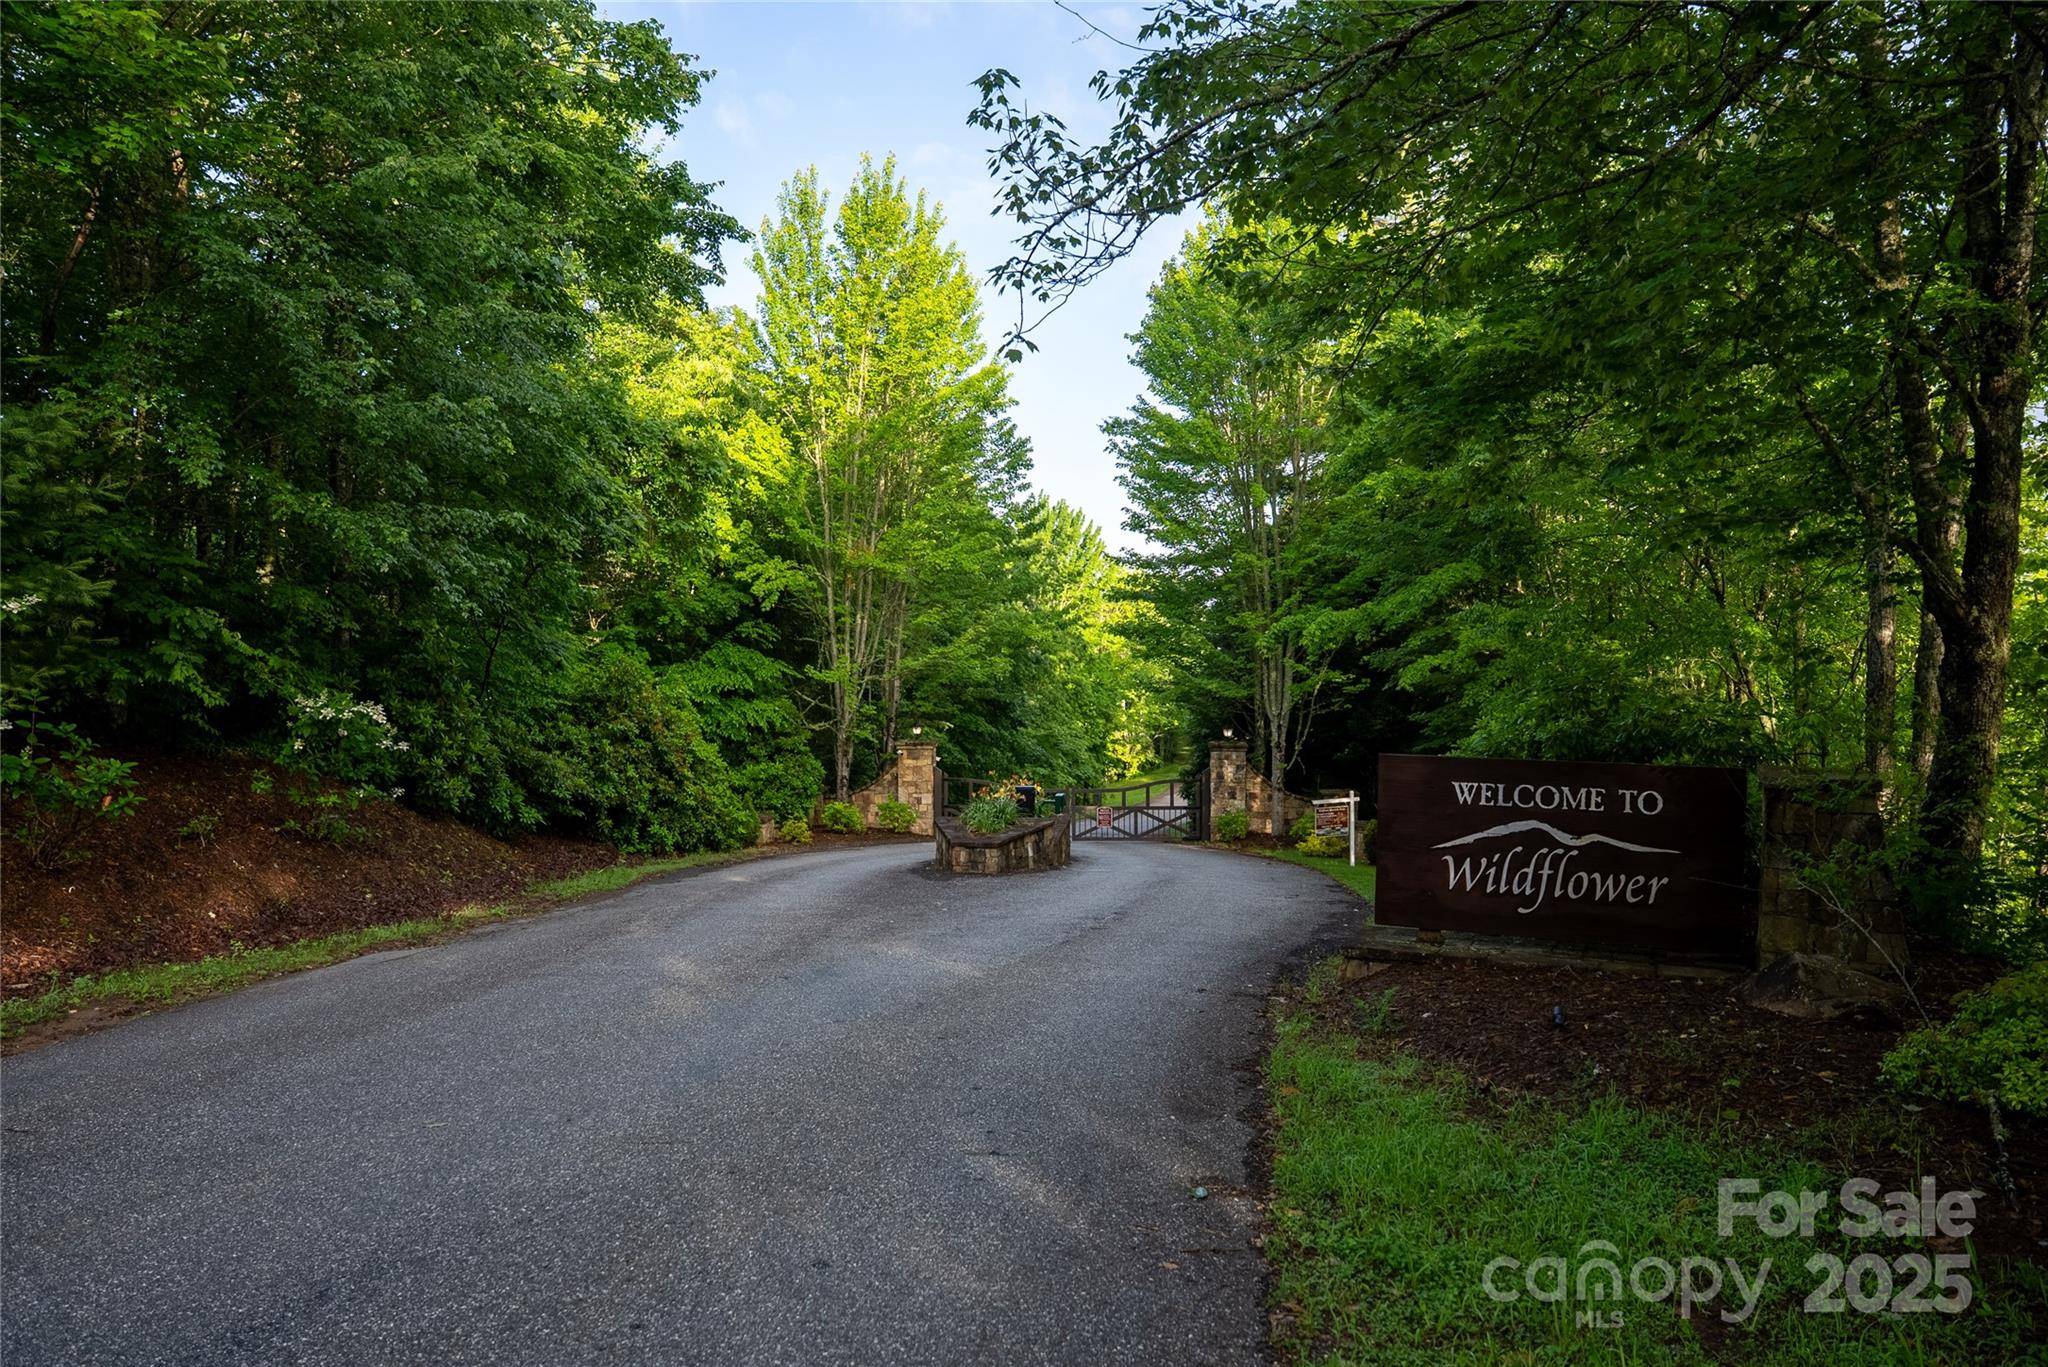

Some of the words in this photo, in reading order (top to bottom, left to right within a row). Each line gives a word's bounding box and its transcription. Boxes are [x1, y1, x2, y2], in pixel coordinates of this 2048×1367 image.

[1451, 781, 1606, 812] WELCOME
[1618, 789, 1664, 815] TO
[1441, 846, 1669, 914] Wildflower
